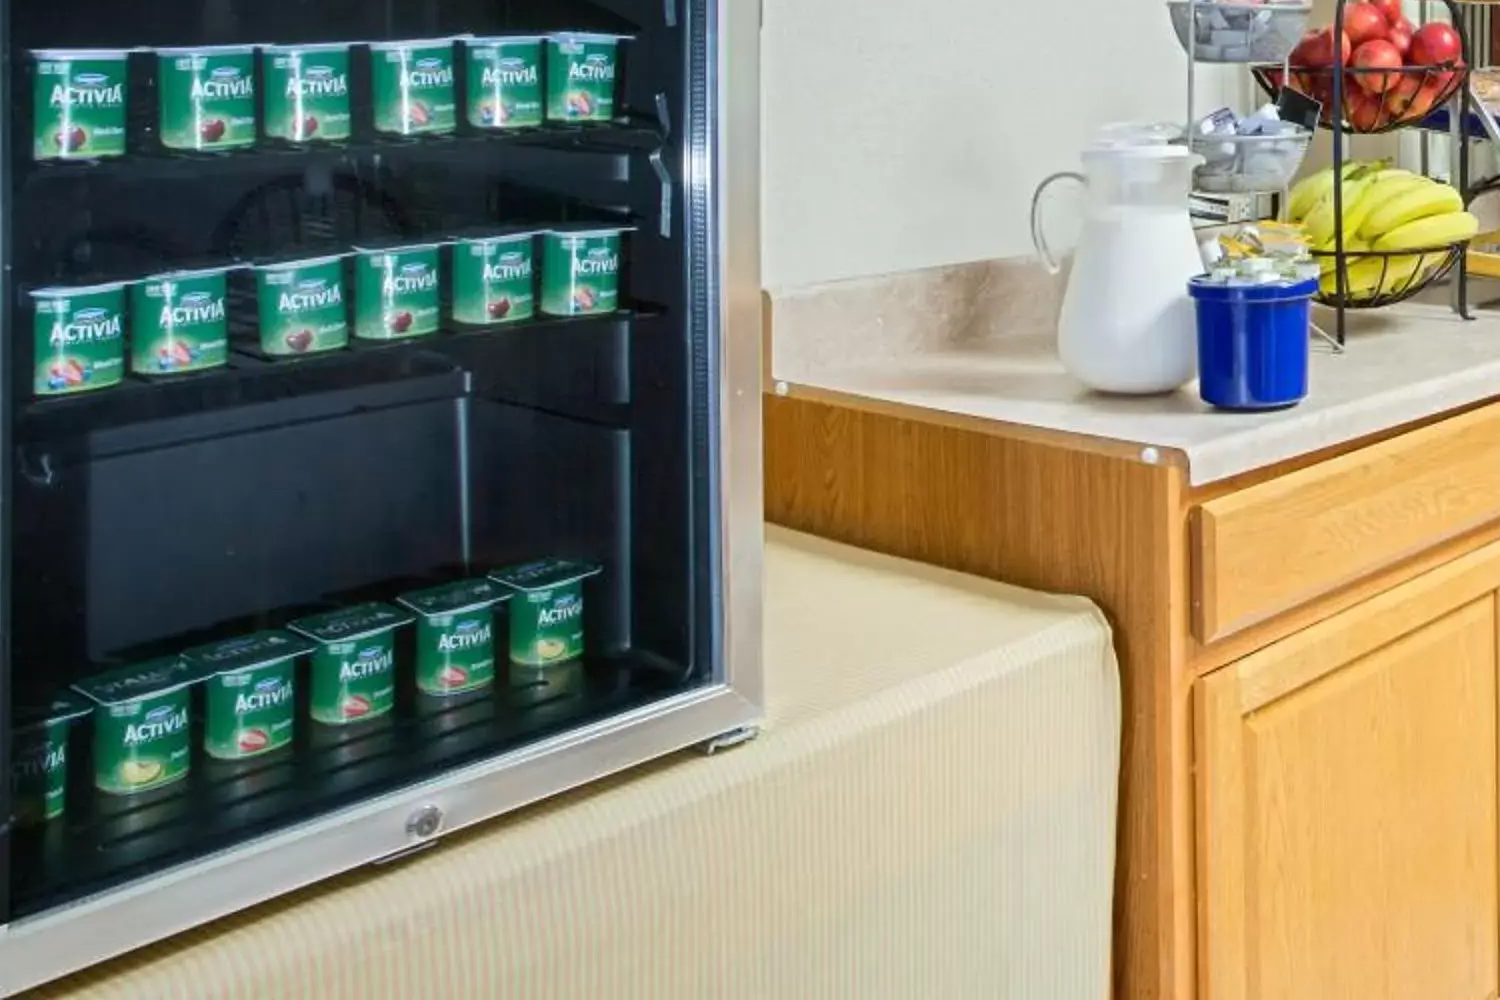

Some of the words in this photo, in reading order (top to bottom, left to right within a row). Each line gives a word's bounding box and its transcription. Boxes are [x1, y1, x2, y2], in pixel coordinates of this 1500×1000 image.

[191, 74, 253, 98] ACTIVIA
[286, 73, 347, 96] ACTIVIA
[482, 65, 537, 84] ACTIVIA
[50, 82, 123, 105] ACTIVIA
[279, 283, 342, 312] ACTIVIA
[160, 297, 225, 327] ACTIVIA
[50, 314, 121, 342] ACTIVIA
[439, 622, 491, 650] ACTIVIA
[235, 679, 294, 714] ACTIVIA
[124, 707, 188, 743] ACTIVIA
